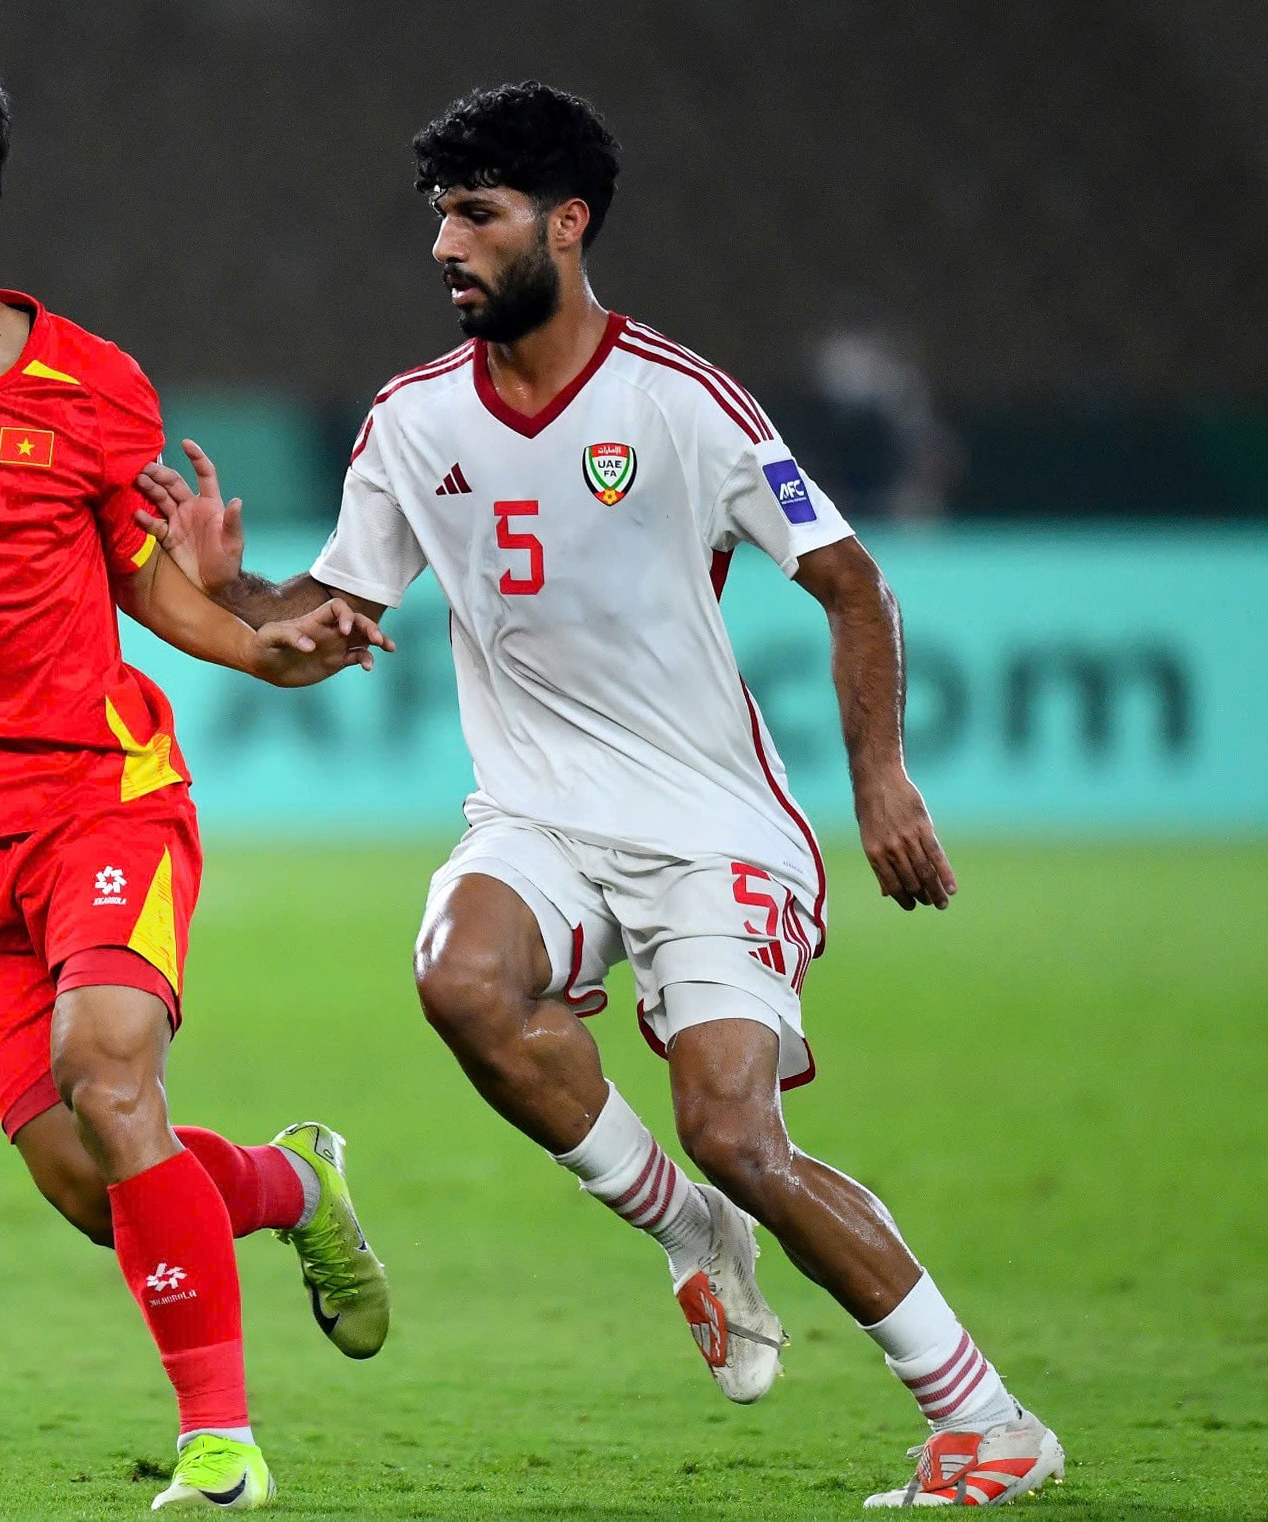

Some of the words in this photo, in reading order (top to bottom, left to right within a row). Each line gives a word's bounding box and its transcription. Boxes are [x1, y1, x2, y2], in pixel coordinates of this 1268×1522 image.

[598, 460, 622, 468] UAE
[779, 480, 804, 500] AFC
[493, 499, 545, 596] 5
[730, 861, 779, 938] 5
